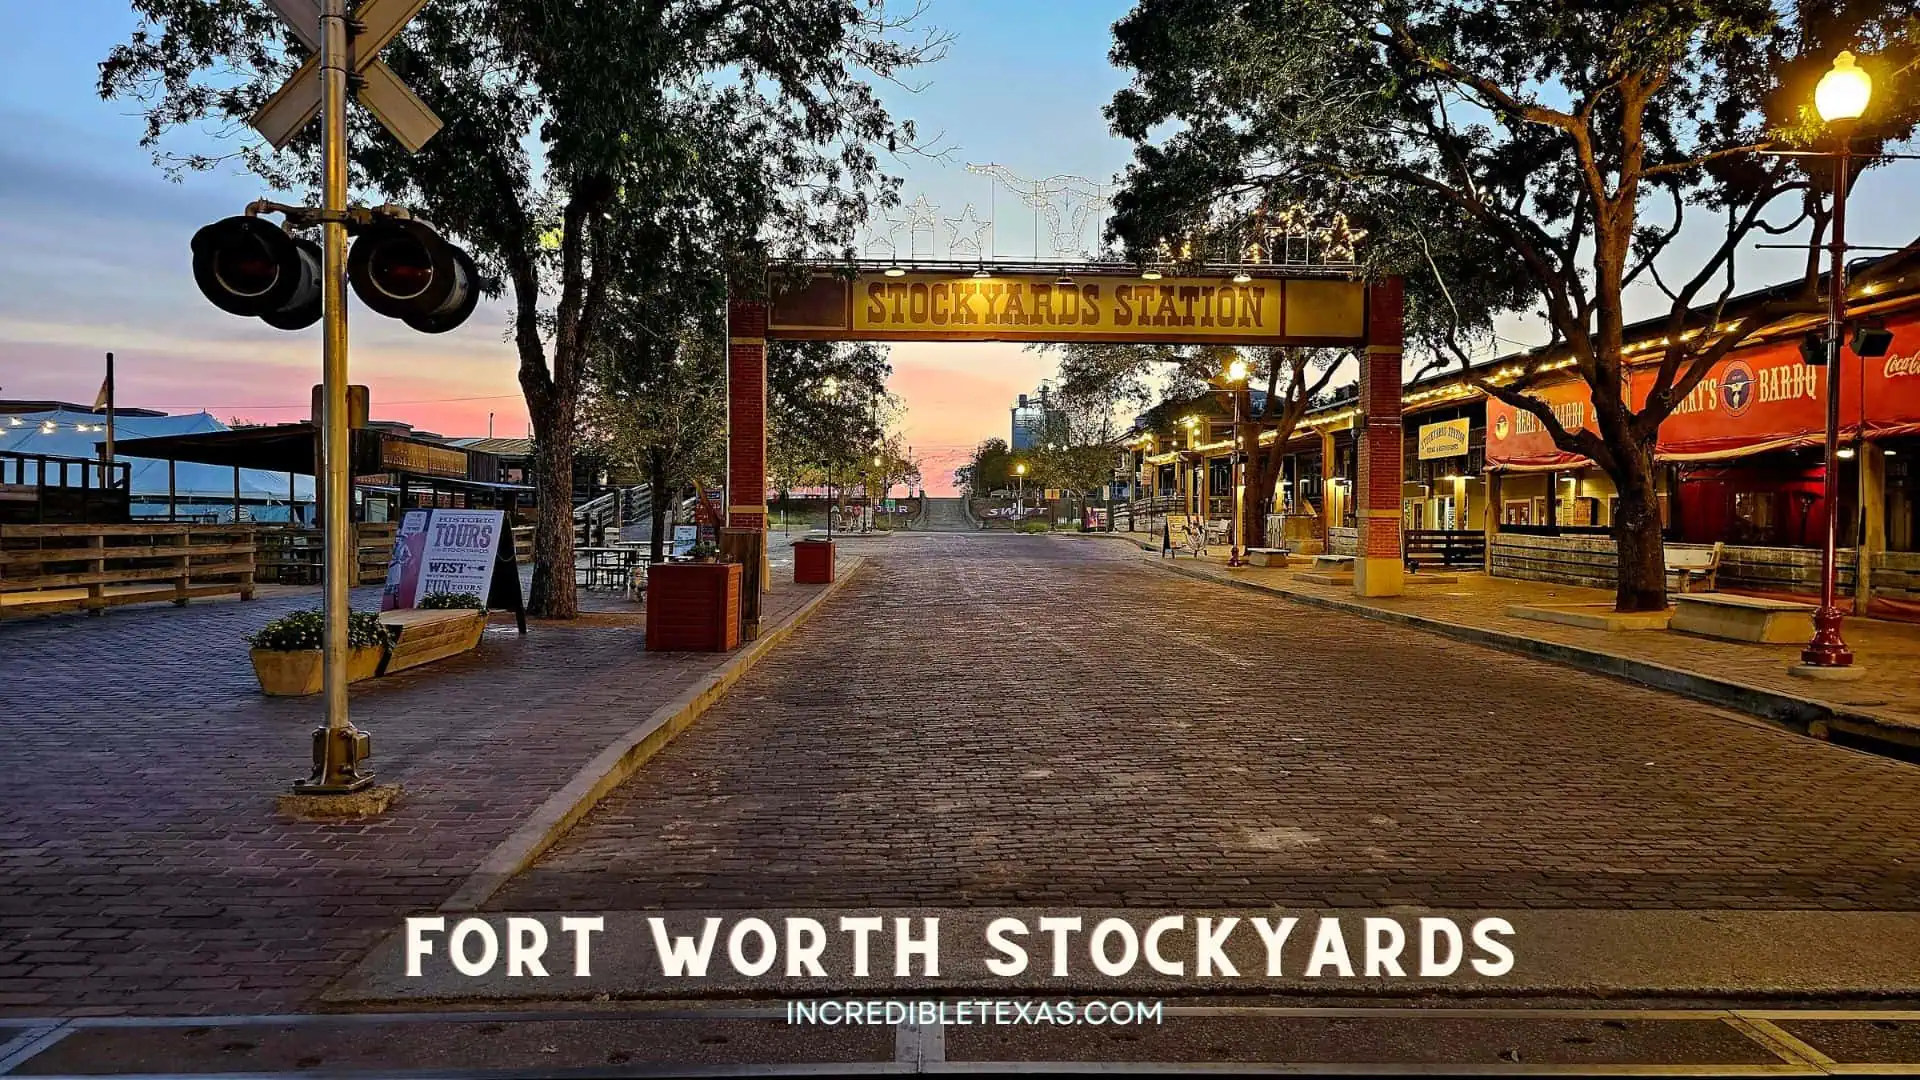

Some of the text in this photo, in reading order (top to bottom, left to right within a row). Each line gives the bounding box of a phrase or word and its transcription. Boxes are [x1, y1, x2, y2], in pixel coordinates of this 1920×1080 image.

[867, 282, 1265, 329] STOCKYARDS STATION
[1516, 409, 1536, 434] REAL
[435, 523, 493, 548] TOURS
[429, 562, 466, 573] WEST
[424, 579, 451, 592] FUN
